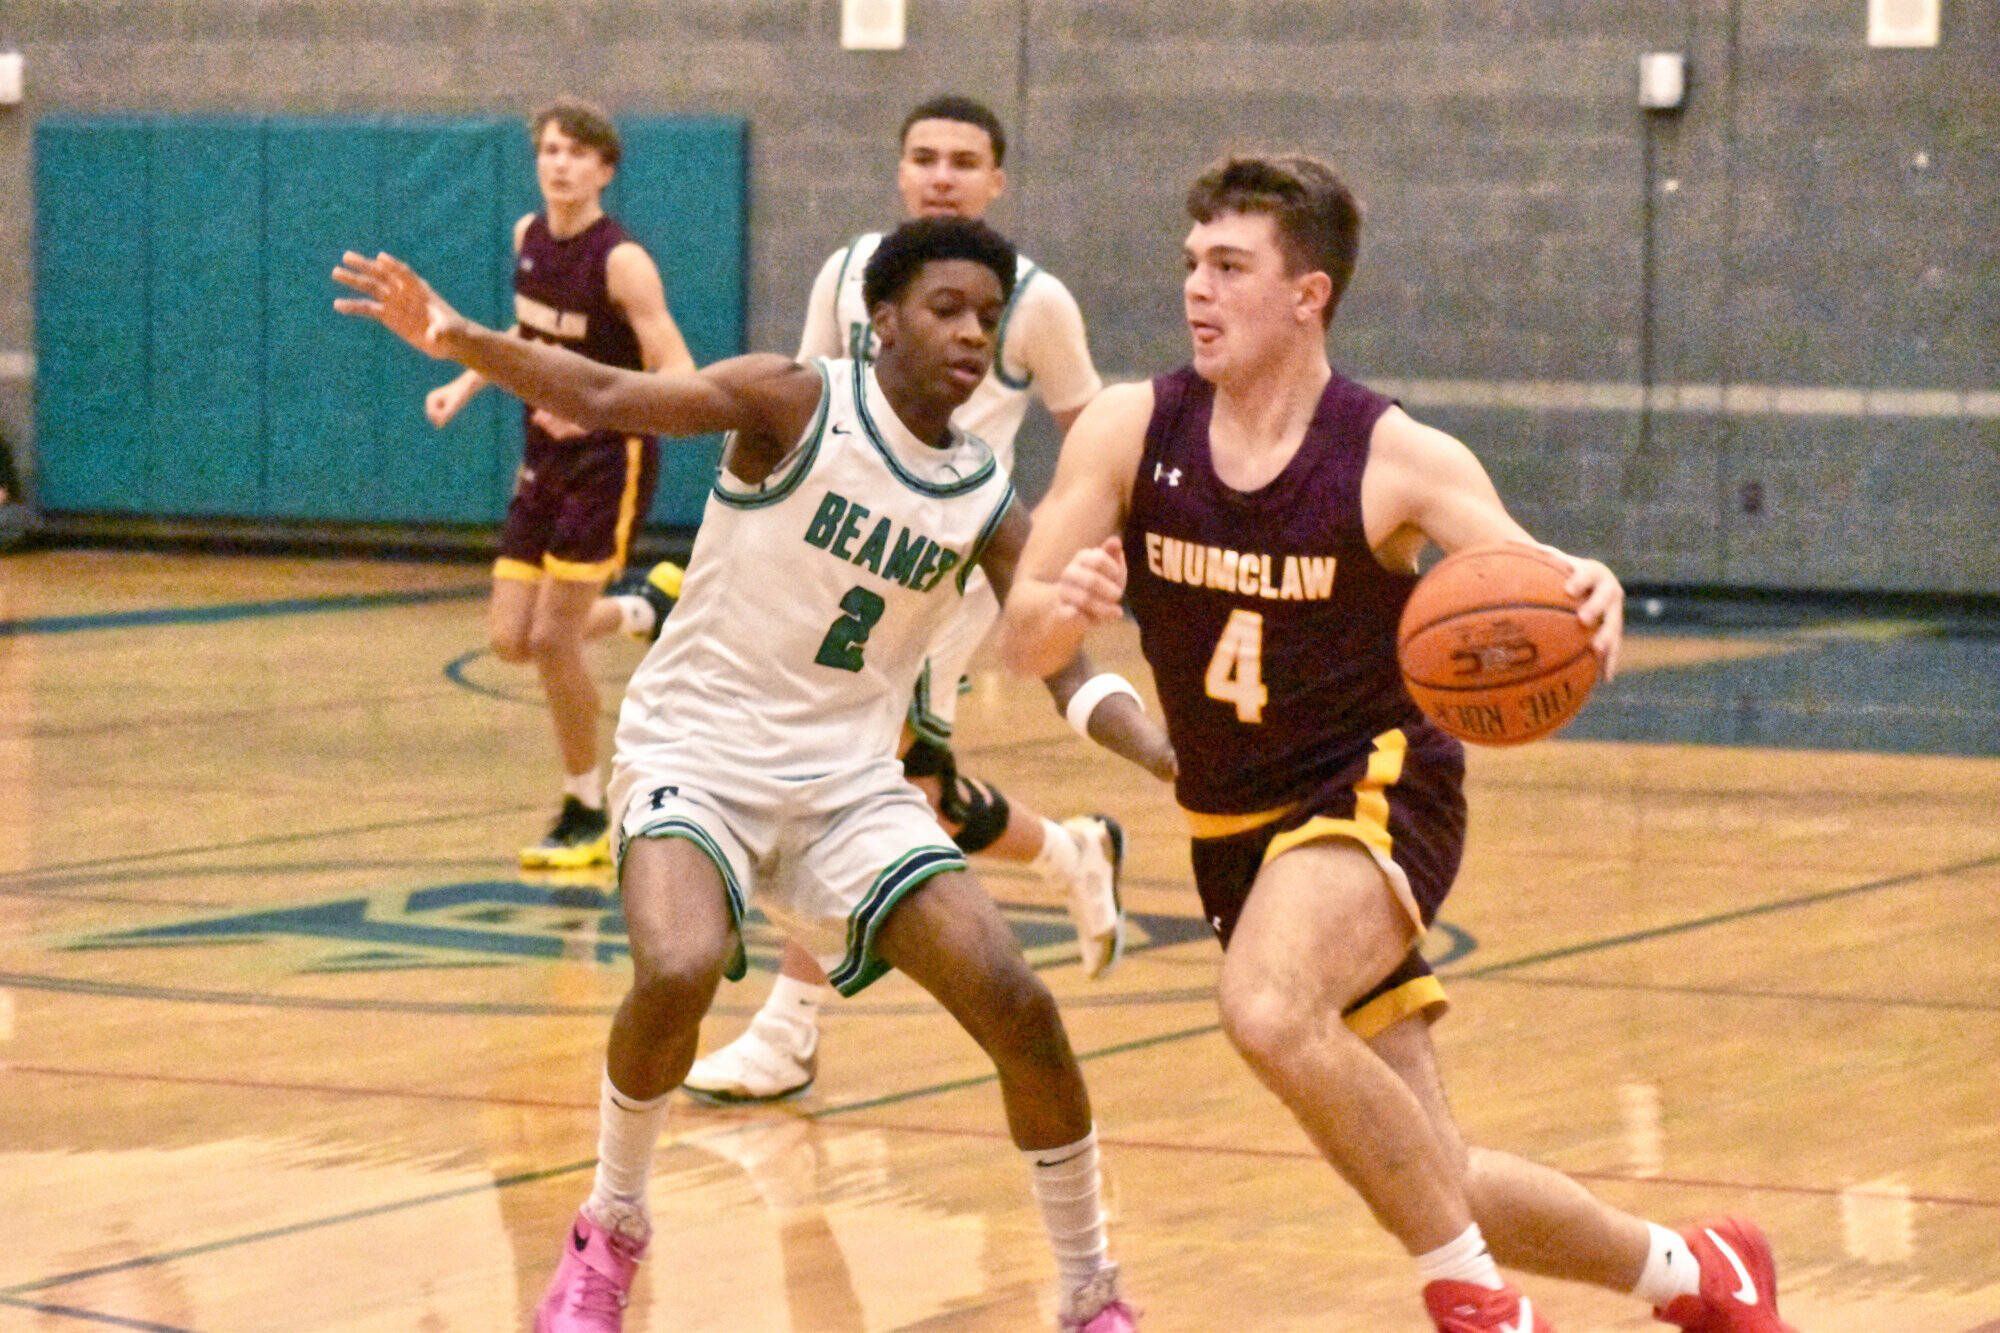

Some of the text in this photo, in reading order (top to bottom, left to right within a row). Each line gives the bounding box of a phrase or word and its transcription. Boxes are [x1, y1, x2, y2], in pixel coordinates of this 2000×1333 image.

[1145, 532, 1336, 601] ENUMCLAW
[814, 585, 885, 673] 2
[1205, 608, 1268, 724] 4
